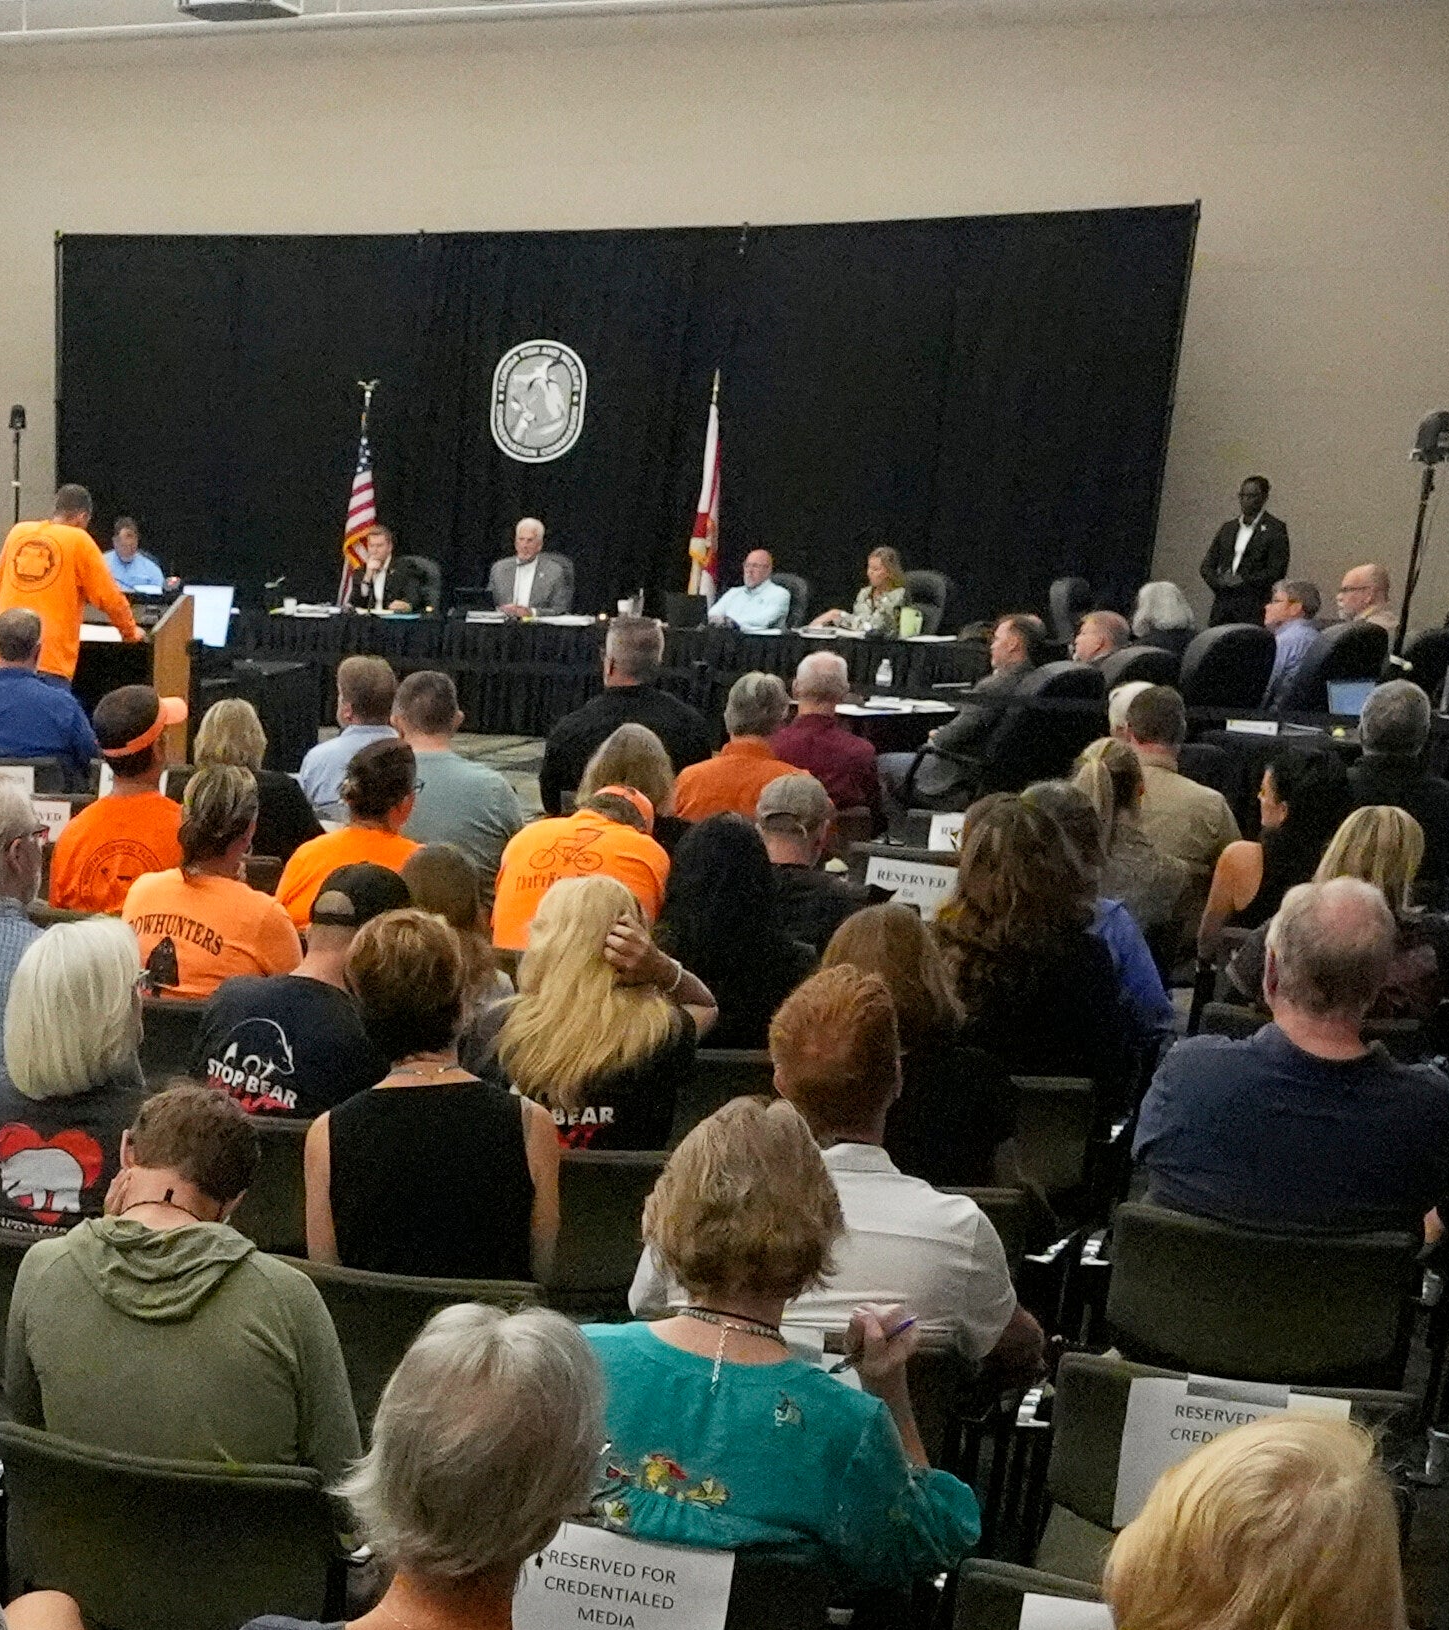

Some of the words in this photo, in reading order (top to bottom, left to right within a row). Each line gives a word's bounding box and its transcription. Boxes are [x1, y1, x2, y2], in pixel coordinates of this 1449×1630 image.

[877, 869, 947, 889] RESERVED
[128, 913, 224, 956] OWHUNTERS
[207, 1057, 245, 1088] STOP
[245, 1075, 298, 1110] BEAR
[552, 1106, 615, 1126] BEAR
[1174, 1404, 1258, 1425] RESERVED
[548, 1549, 636, 1578] RESERVED
[641, 1566, 676, 1584] FOR
[544, 1575, 674, 1610] CREDENTIALED
[577, 1606, 635, 1629] MEDIA
